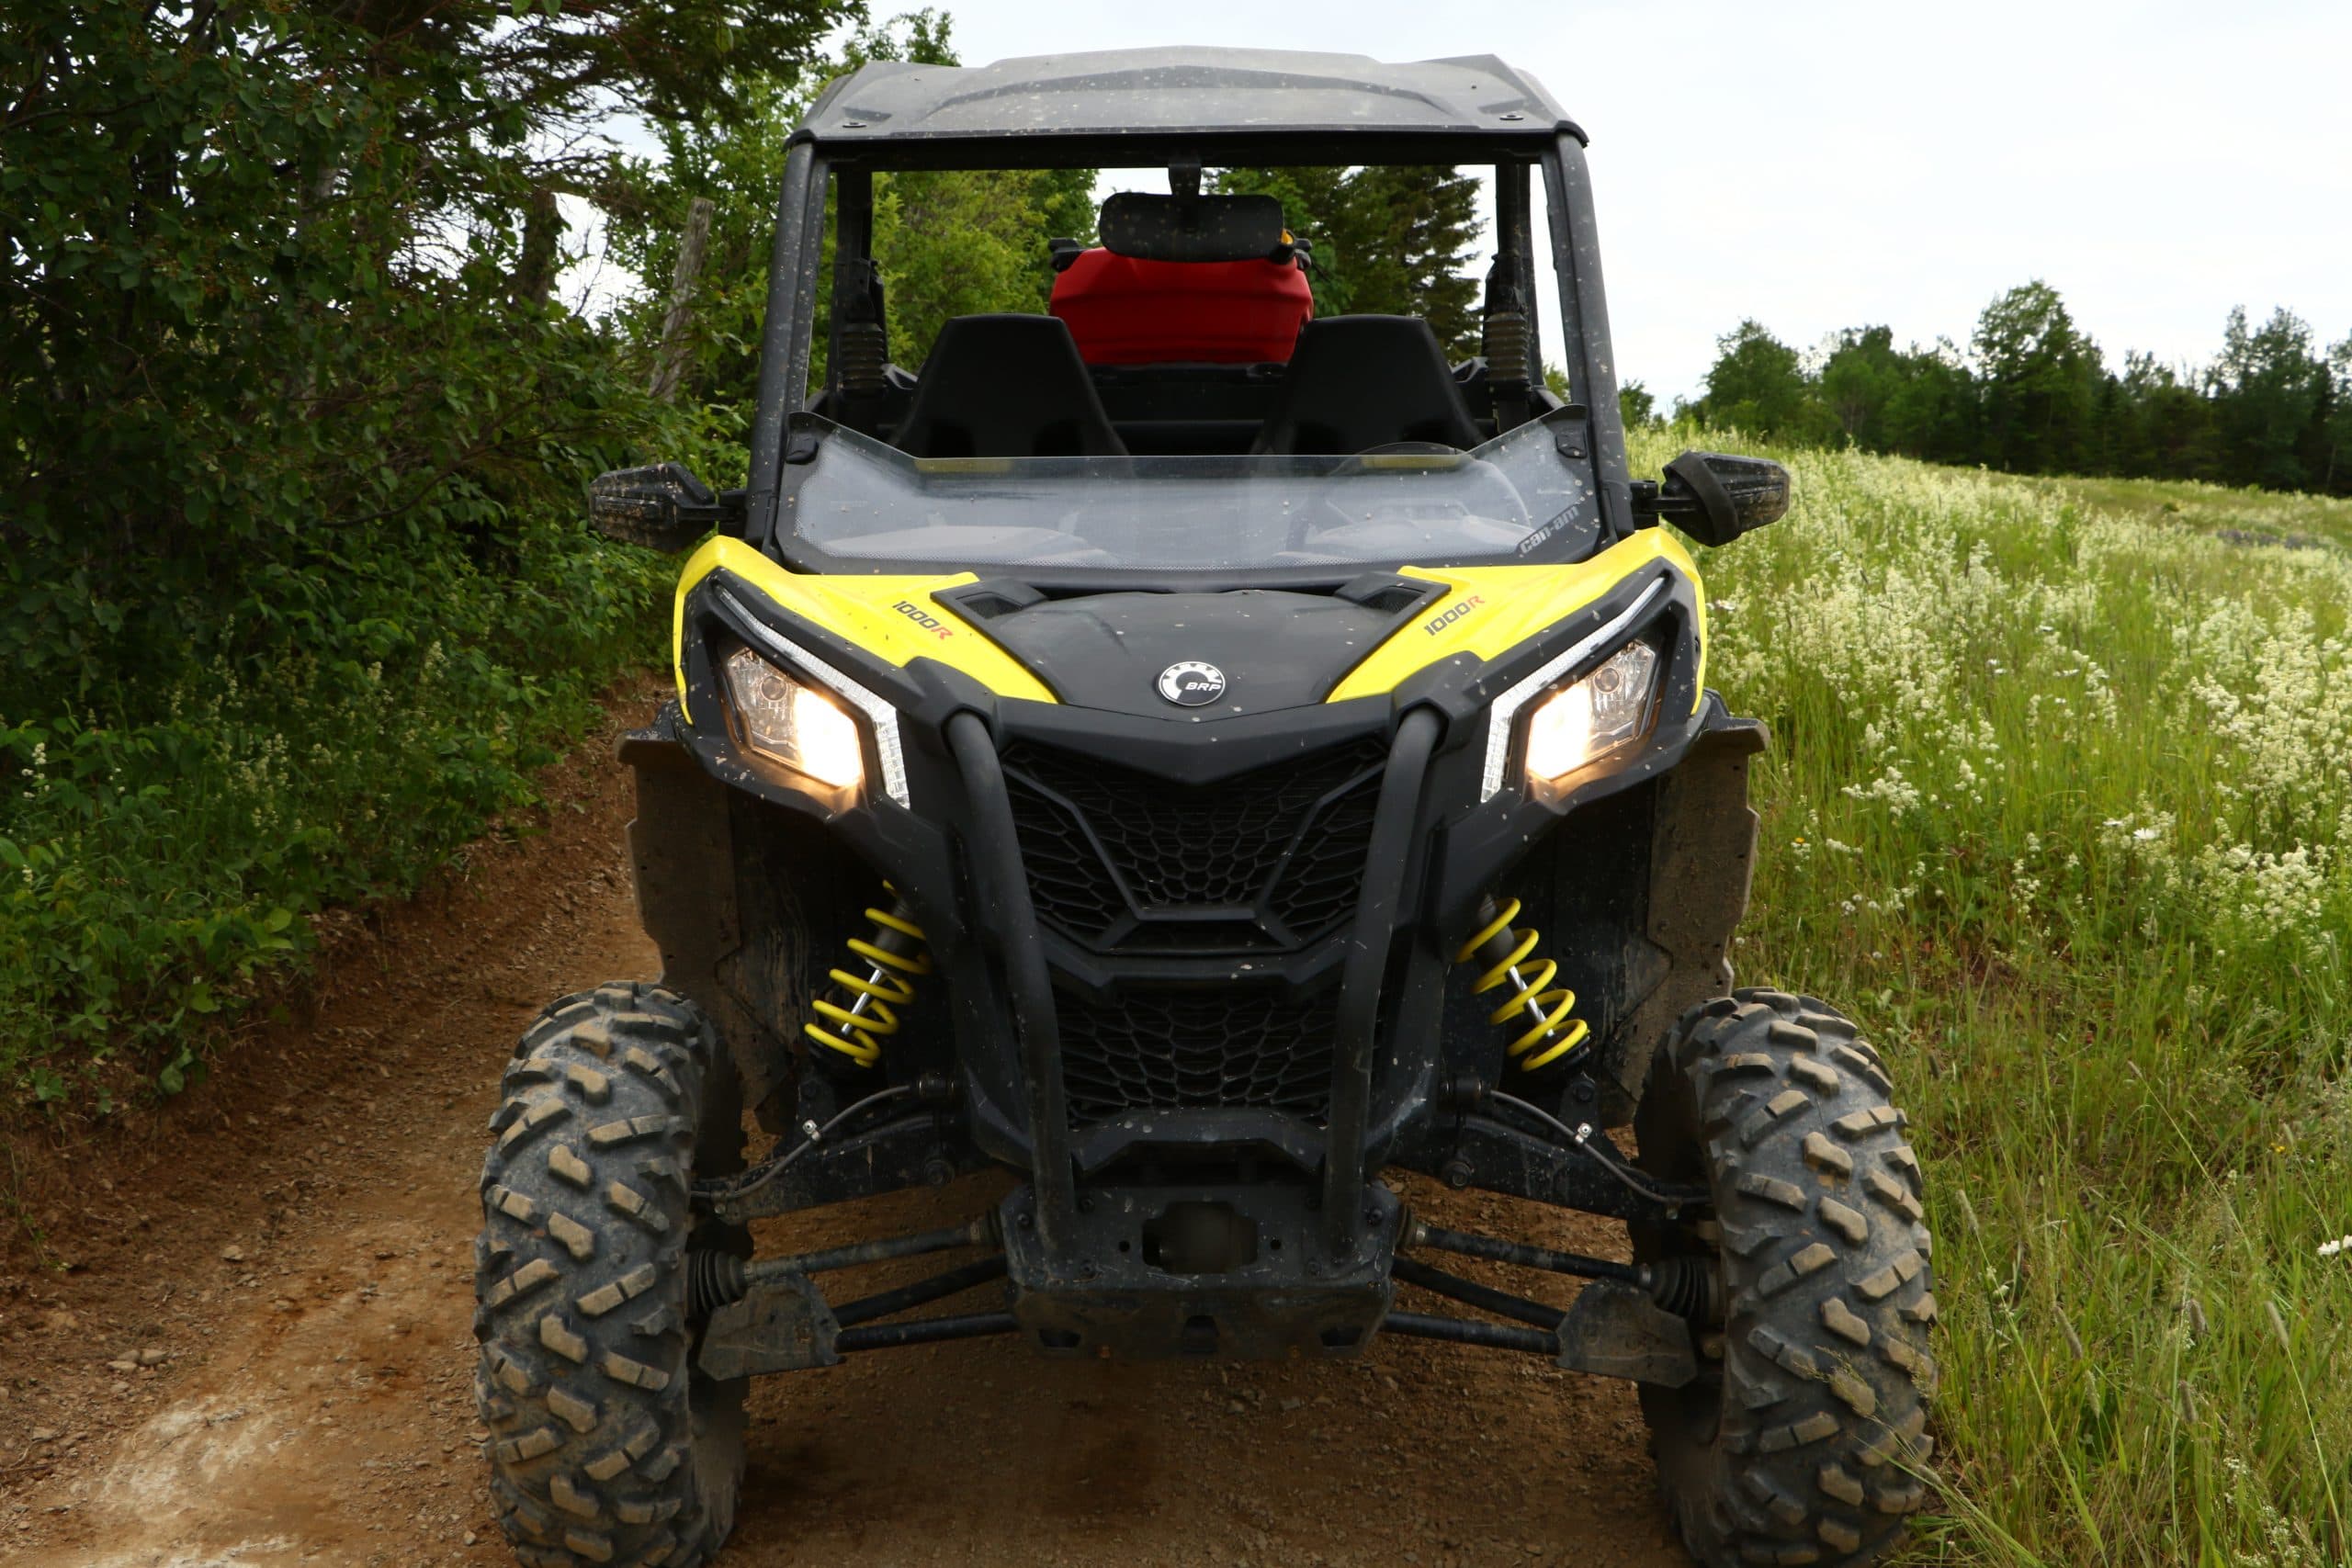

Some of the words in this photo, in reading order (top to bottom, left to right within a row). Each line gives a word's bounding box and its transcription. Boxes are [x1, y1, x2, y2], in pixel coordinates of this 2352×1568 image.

[1520, 505, 1579, 554] can-am
[892, 600, 953, 639] 1000R
[1424, 595, 1485, 636] 1000R
[1184, 682, 1221, 691] BRP
